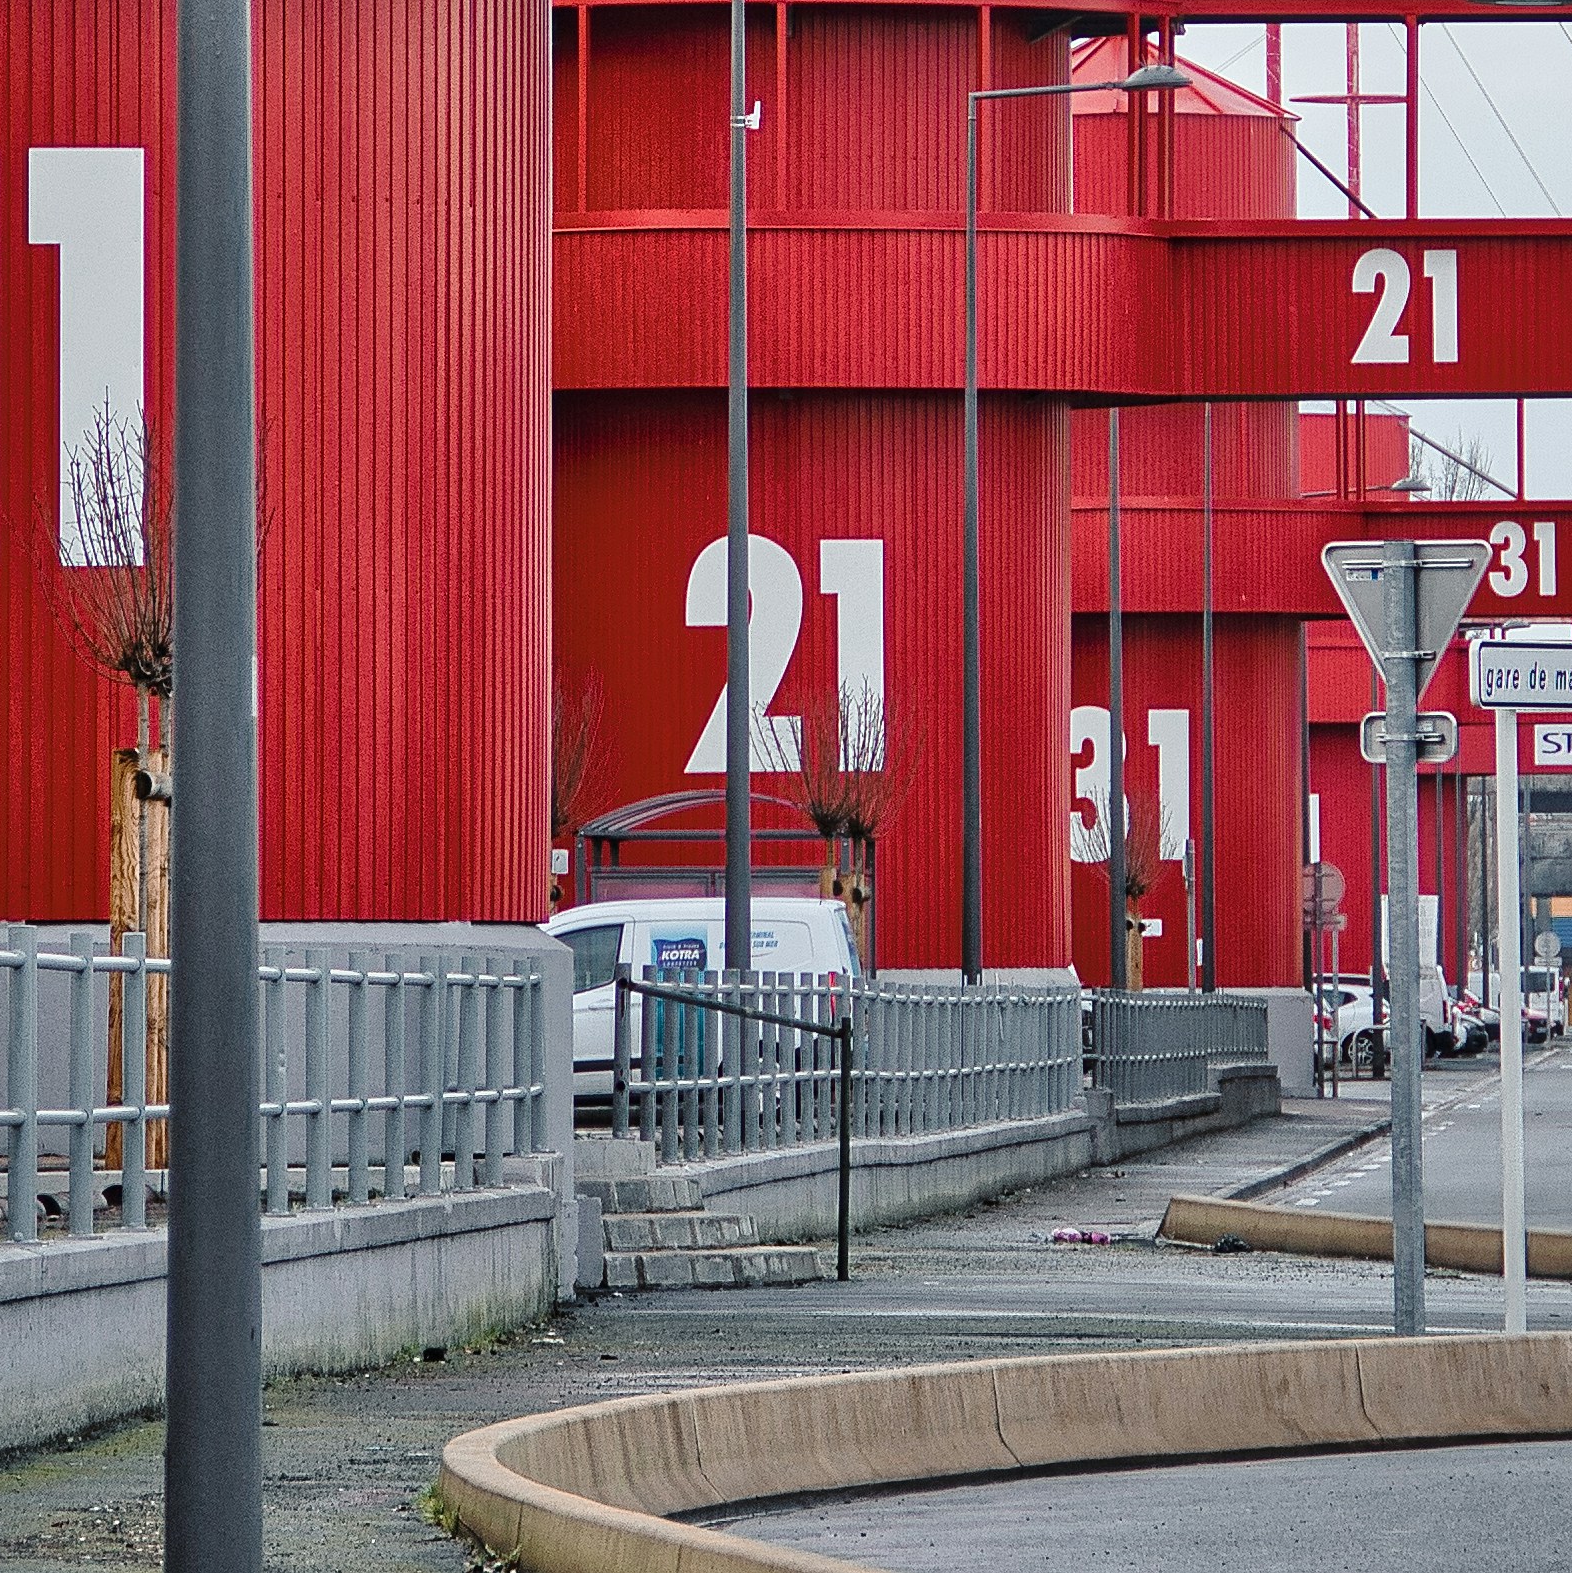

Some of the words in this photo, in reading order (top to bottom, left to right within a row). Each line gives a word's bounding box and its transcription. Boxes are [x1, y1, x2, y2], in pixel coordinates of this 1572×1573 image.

[1351, 248, 1459, 364] 21
[1489, 520, 1557, 597] 31
[684, 533, 885, 773] 21
[1486, 667, 1520, 697] gare
[1530, 661, 1546, 690] de
[662, 949, 699, 960] KOTRA
